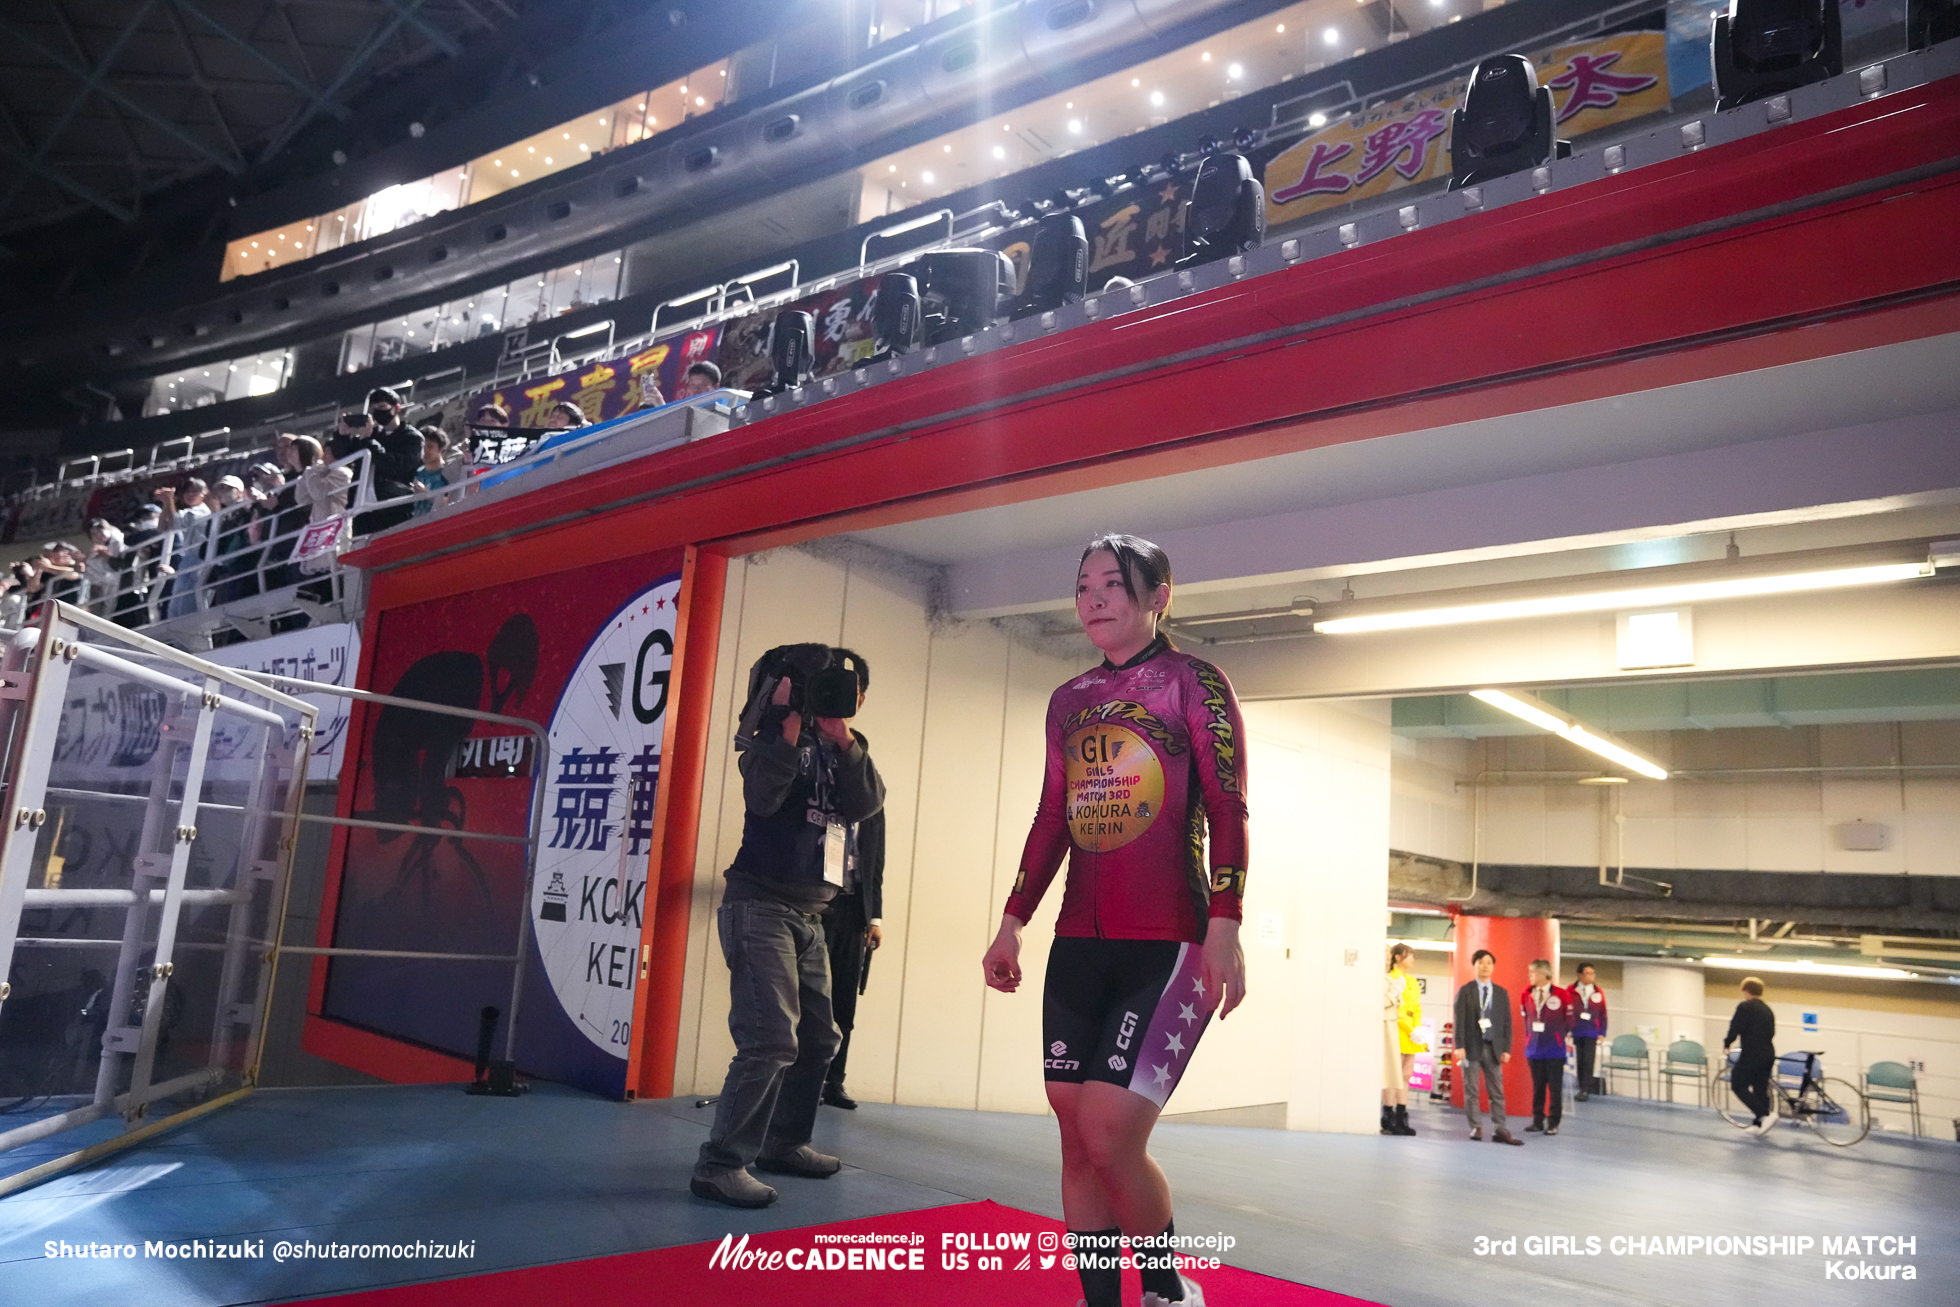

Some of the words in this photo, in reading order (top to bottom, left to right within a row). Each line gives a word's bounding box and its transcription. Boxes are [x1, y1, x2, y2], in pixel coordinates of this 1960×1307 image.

[1086, 765, 1114, 777] GIRLS
[1070, 775, 1140, 791] CHAMPIONSHIP
[1076, 791, 1106, 803] MATCH
[1107, 788, 1131, 801] 3RD
[1075, 803, 1131, 819] KOKURA
[1080, 822, 1123, 835] KEIRIN
